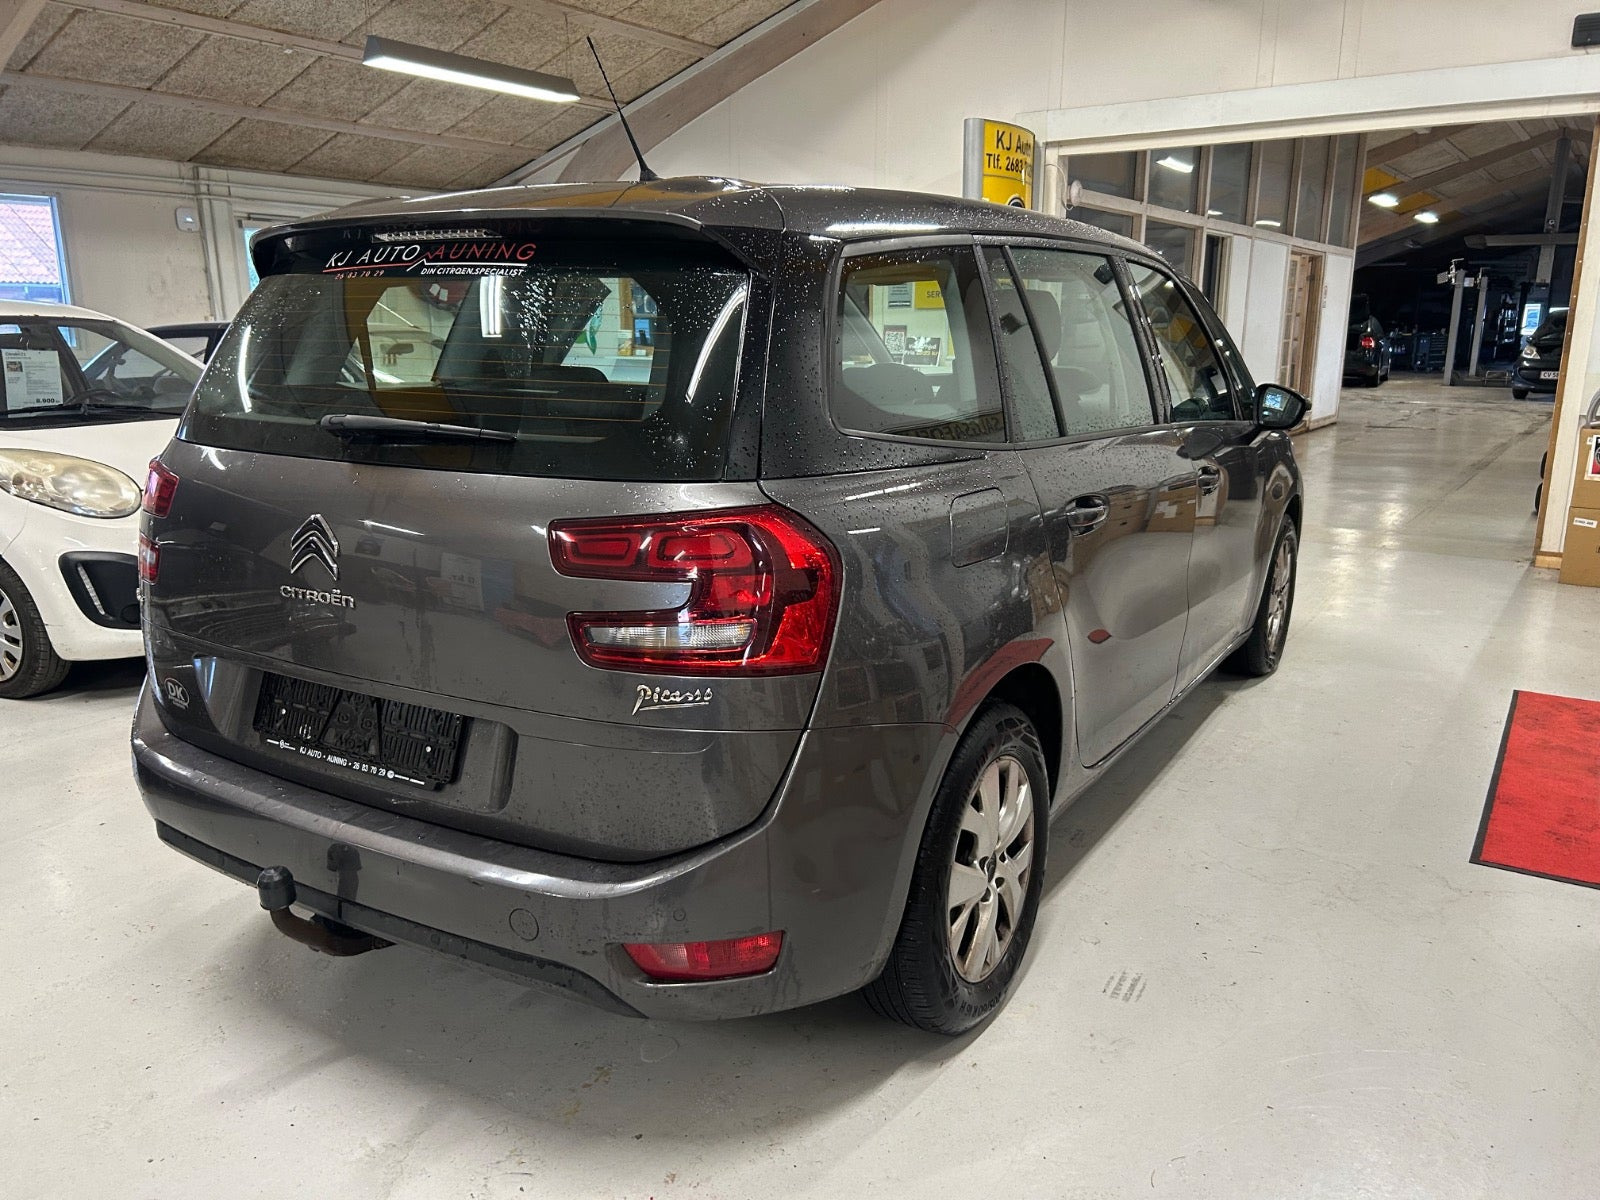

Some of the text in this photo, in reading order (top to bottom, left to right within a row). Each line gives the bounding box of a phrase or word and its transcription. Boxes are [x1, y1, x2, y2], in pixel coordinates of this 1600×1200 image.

[996, 129, 1012, 151] KJ
[986, 153, 1002, 170] Tlf.
[325, 243, 537, 268] KJ AUTO AUNING
[420, 267, 437, 275] DIN
[926, 290, 941, 299] SER
[166, 681, 186, 701] DK
[632, 684, 713, 716] Picasso
[299, 746, 307, 754] KJ
[307, 749, 322, 759] AUTO
[326, 754, 348, 767] AUNING
[378, 768, 386, 777] 29
